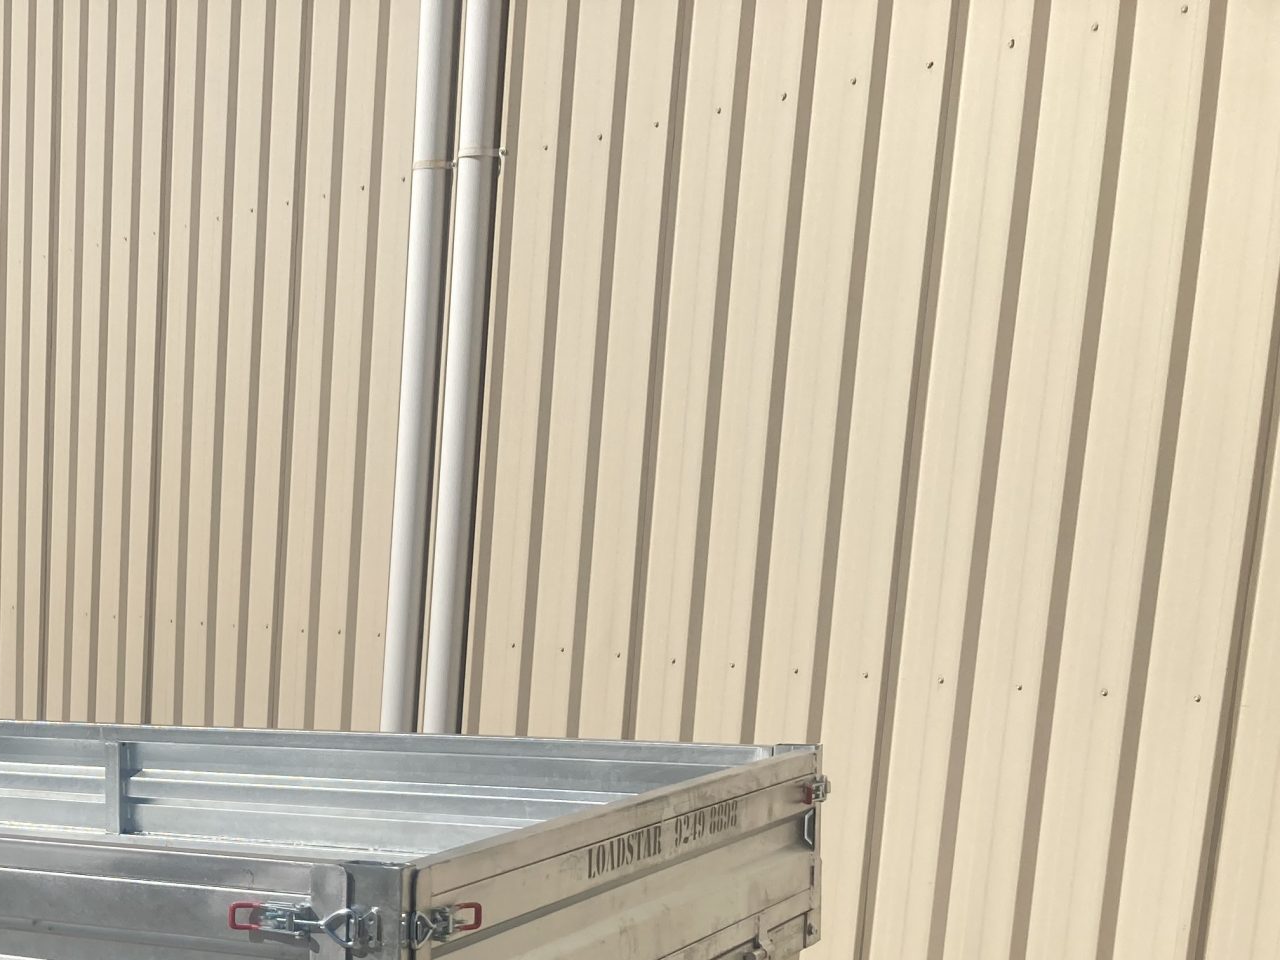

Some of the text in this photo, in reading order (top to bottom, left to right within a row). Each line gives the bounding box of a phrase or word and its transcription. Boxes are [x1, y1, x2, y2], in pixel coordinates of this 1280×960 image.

[587, 799, 738, 880] LOADSTAR 9249 8898
